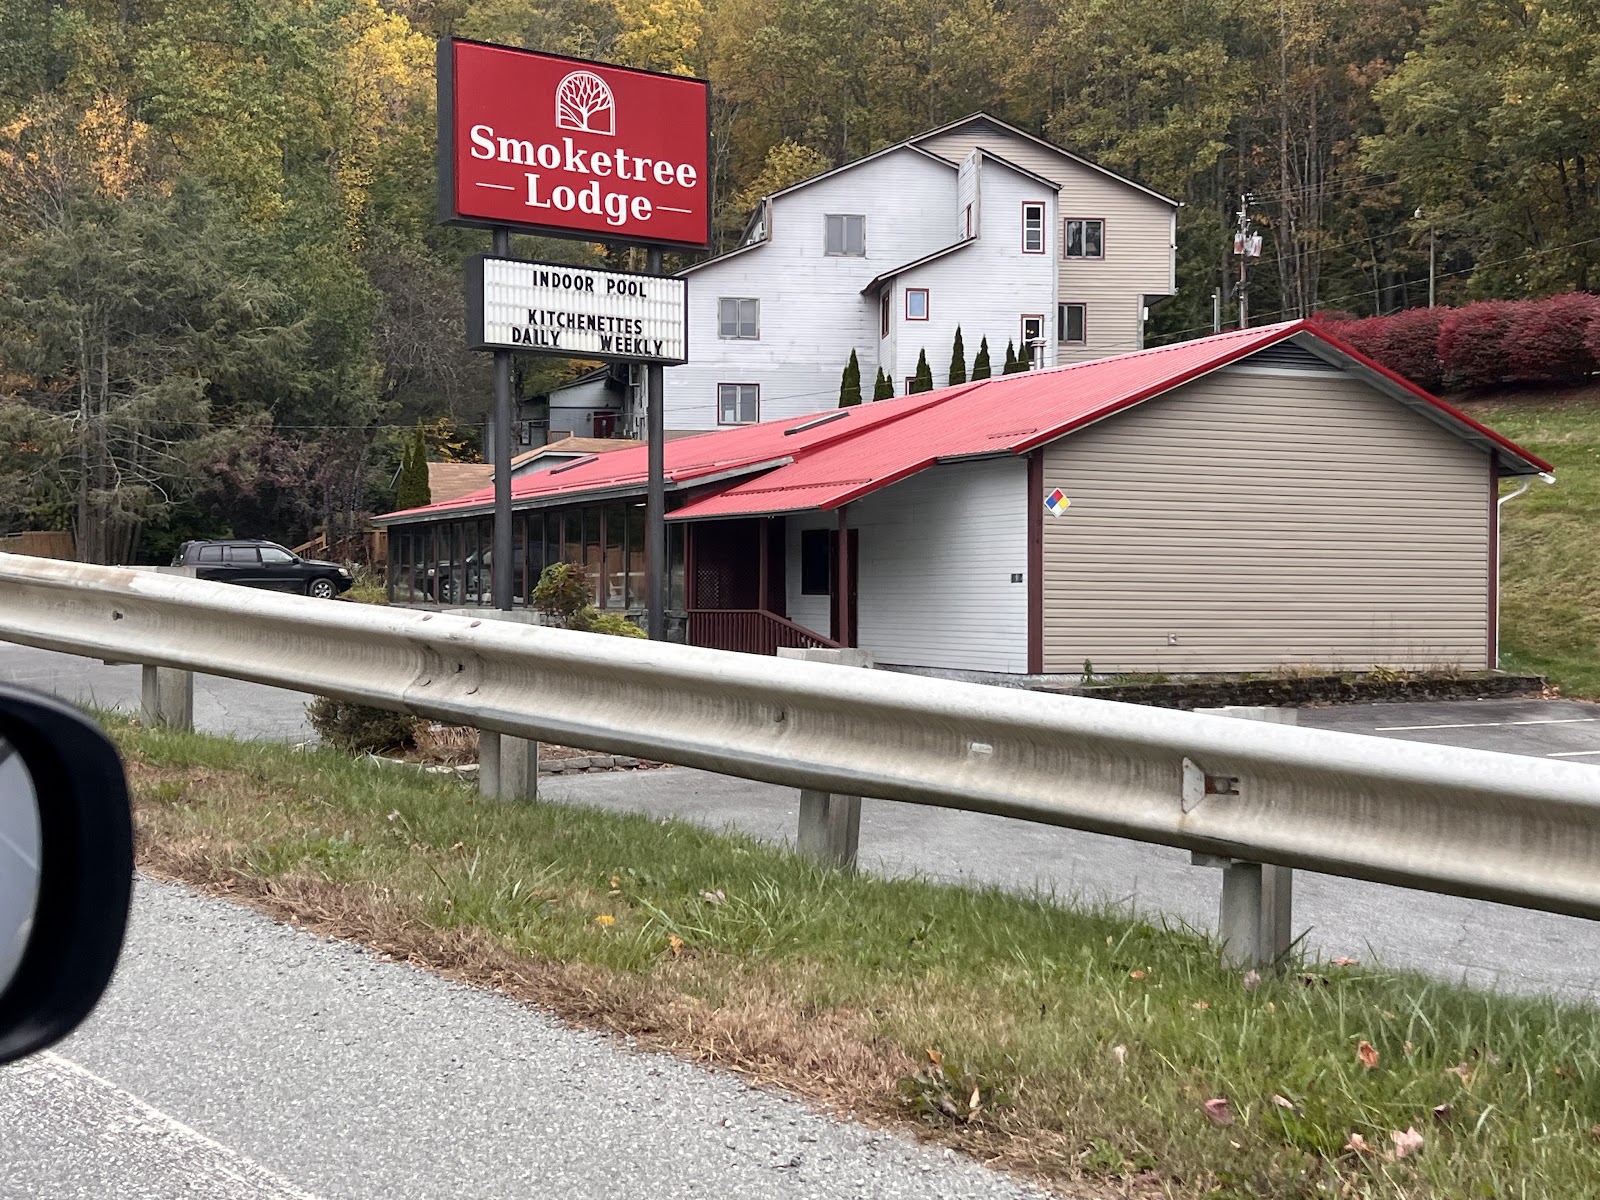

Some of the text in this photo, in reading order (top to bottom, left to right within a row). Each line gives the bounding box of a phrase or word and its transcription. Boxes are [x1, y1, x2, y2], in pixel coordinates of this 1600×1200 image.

[470, 124, 698, 188] Smoketree
[524, 172, 652, 226] Lodge
[533, 270, 647, 298] INDOOR POOL
[528, 308, 642, 335] KITCHENETTES
[512, 327, 663, 356] DAILY WEEKLY
